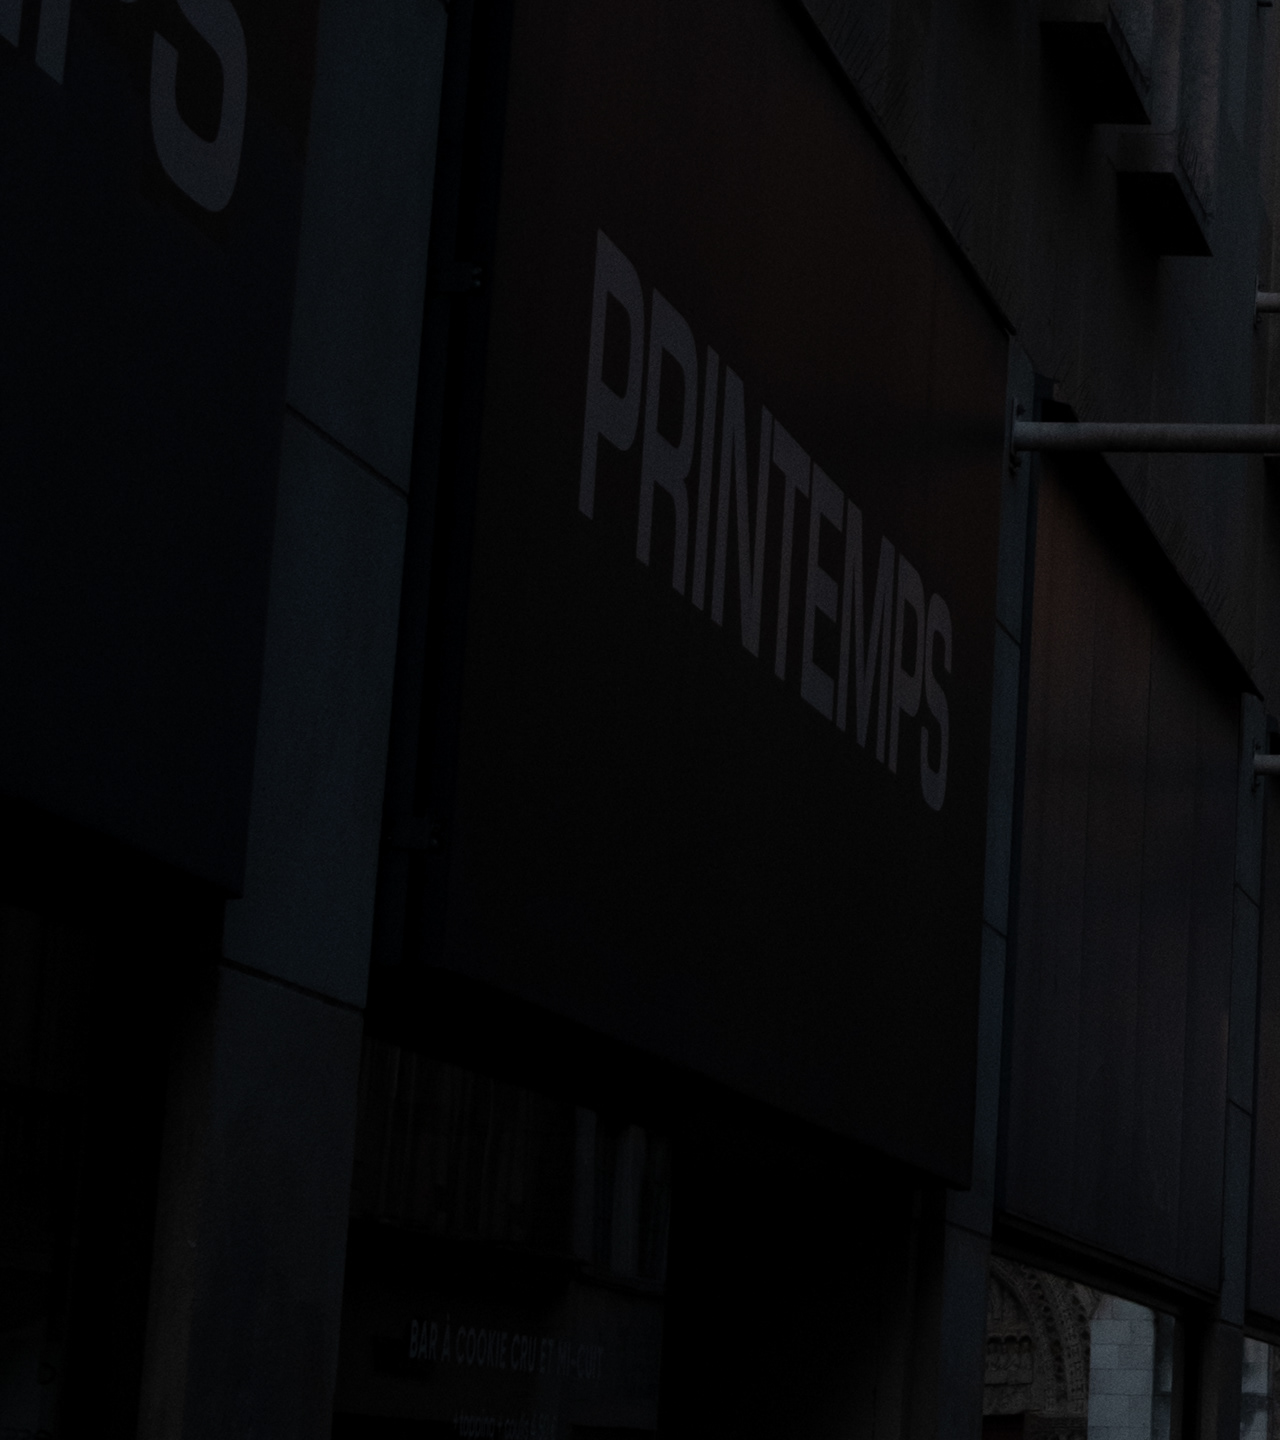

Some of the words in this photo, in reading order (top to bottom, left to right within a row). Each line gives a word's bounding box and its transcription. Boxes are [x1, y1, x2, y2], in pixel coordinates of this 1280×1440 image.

[578, 227, 952, 812] PRINTEMPS
[408, 1318, 439, 1361] BAR
[440, 1312, 451, 1362] À
[454, 1325, 508, 1369] COOKIE
[509, 1332, 538, 1373] CRU
[539, 1336, 555, 1374] ET
